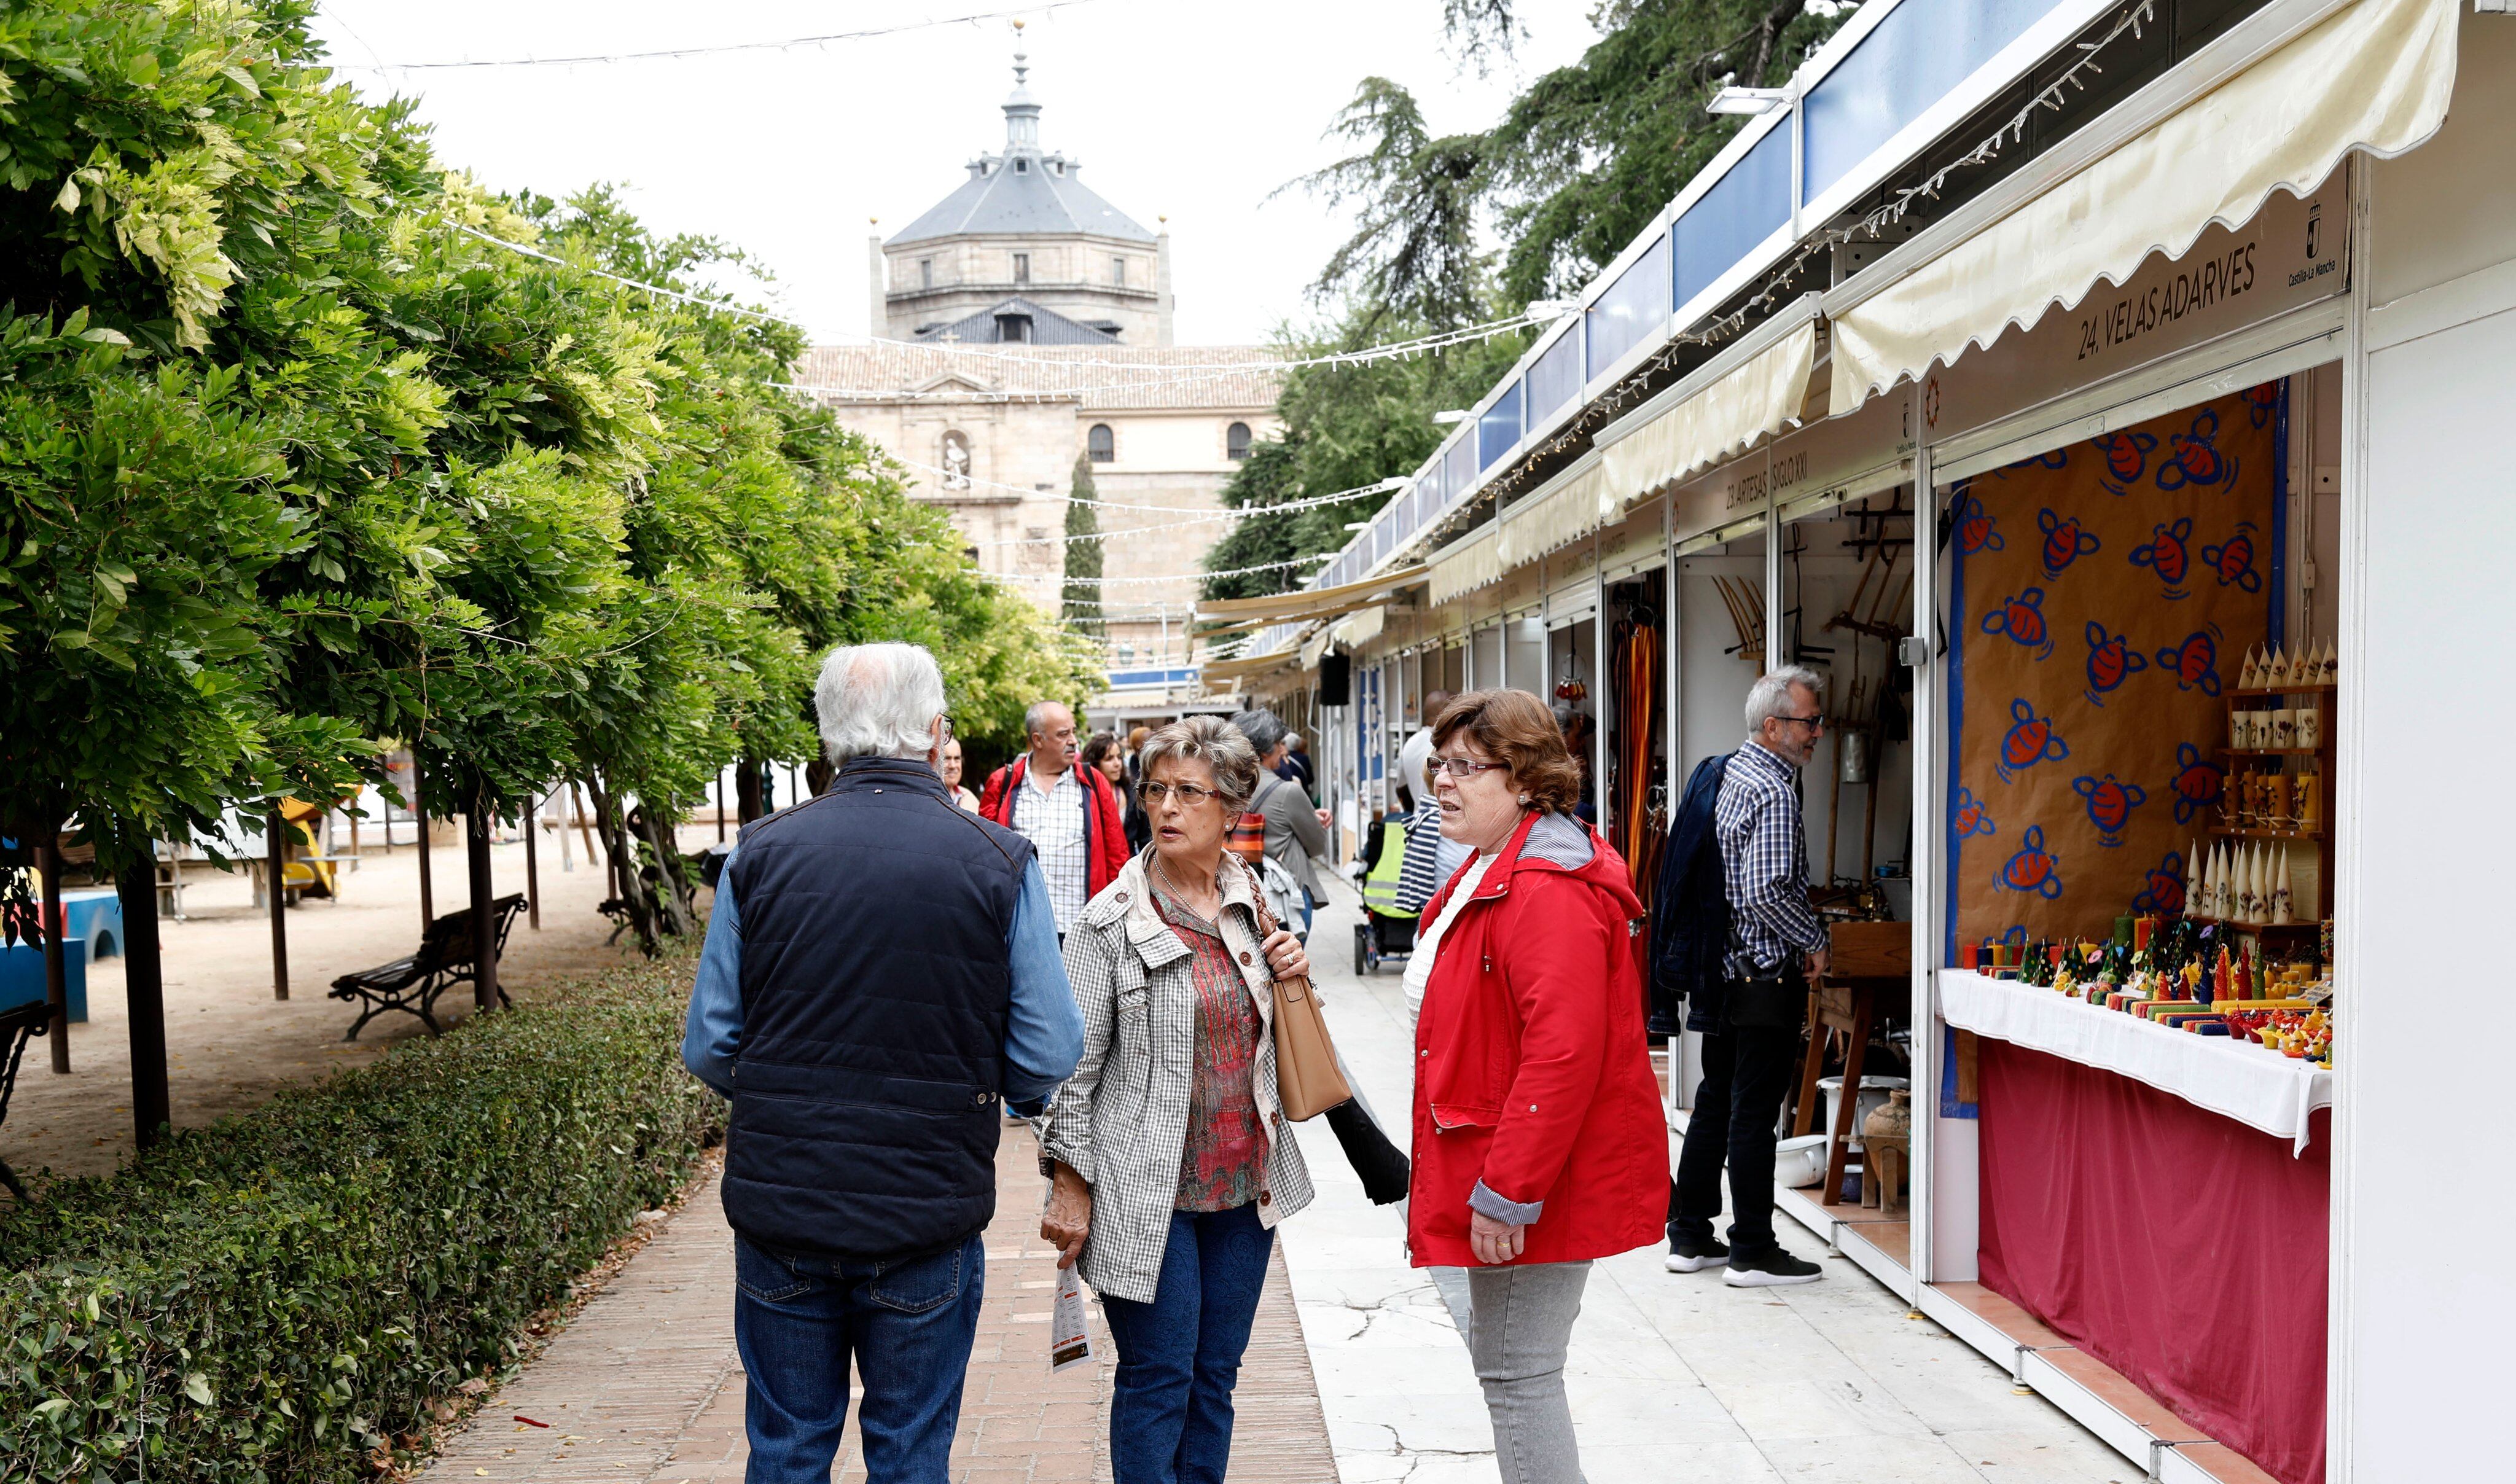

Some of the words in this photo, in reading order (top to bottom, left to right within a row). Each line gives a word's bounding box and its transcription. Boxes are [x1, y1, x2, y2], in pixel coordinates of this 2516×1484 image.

[2078, 314, 2099, 361] 24.
[2106, 286, 2159, 349] VELAS
[2159, 241, 2256, 327] ADARVES
[2289, 267, 2315, 287] Castilla-La
[2315, 259, 2335, 277] Mancha
[1726, 484, 1736, 510] 23.
[1736, 471, 1767, 507] ARTESAS
[1773, 456, 1794, 491] SIGLO
[1795, 450, 1807, 483] XXI
